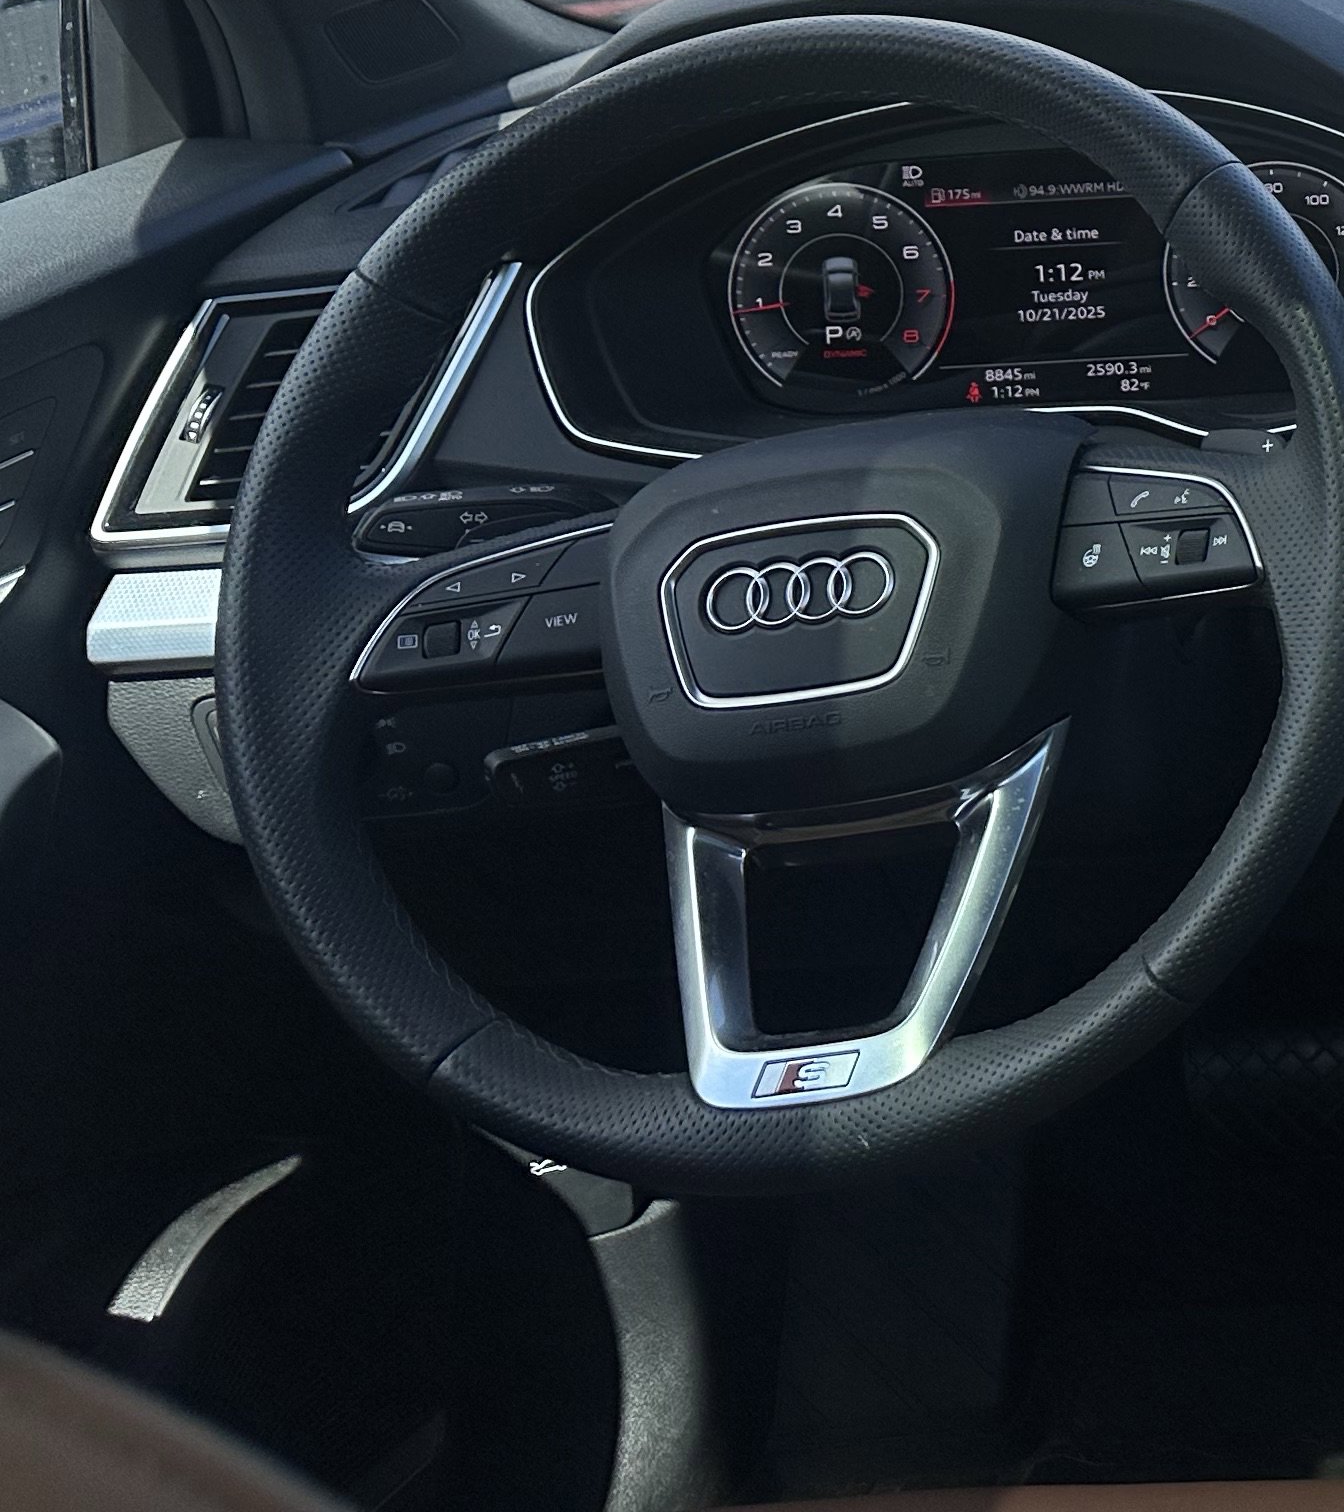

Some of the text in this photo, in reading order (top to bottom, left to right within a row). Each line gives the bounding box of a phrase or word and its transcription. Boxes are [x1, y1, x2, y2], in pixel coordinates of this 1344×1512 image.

[1304, 193, 1330, 206] 100
[827, 204, 843, 218] 4
[786, 219, 802, 234] 3
[872, 215, 889, 230] 5
[1014, 227, 1099, 243] Date & time
[757, 252, 773, 267] 2
[902, 245, 919, 260] 6
[1034, 262, 1106, 283] 1:12 PM
[915, 289, 932, 303] 7
[1032, 289, 1089, 304] Tuesday
[1017, 305, 1106, 322] 10/21/2025
[825, 326, 843, 345] P
[903, 329, 919, 343] 8
[544, 612, 578, 628] VIEW
[468, 629, 481, 640] OK
[748, 711, 842, 736] AIRBAG
